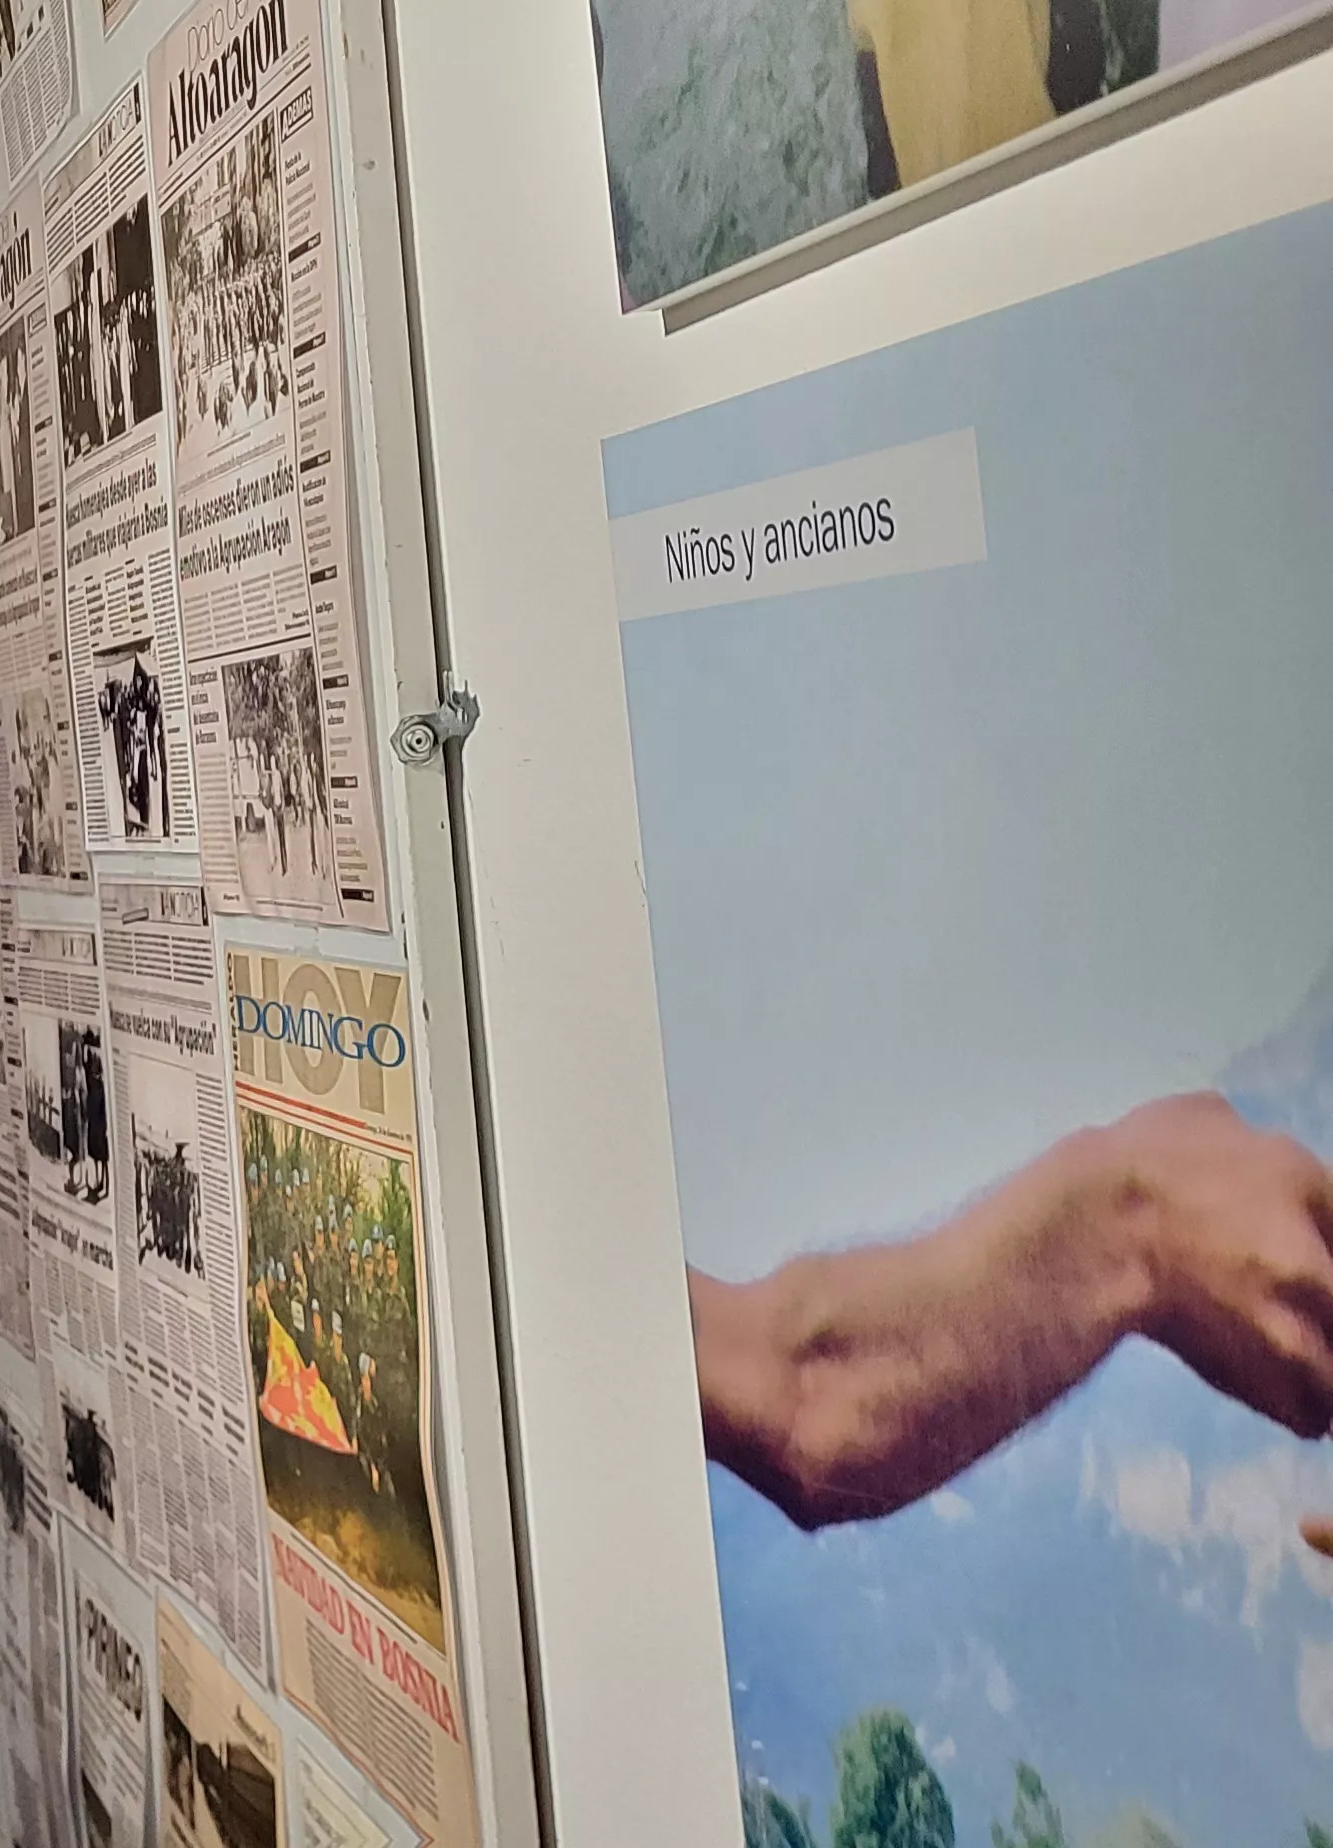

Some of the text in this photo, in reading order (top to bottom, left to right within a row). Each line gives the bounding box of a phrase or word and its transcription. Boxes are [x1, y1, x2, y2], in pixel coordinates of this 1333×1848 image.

[145, 495, 168, 534] Bosnia
[194, 498, 202, 531] de
[203, 490, 236, 527] oscenses
[236, 478, 261, 514] dieron
[260, 475, 272, 504] un
[272, 454, 294, 499] adiós
[180, 543, 207, 581] emotivo
[211, 537, 219, 571] la
[219, 519, 263, 574] Agrupación
[262, 506, 291, 556] Aragón
[665, 497, 896, 583] Niños y ancianos
[234, 954, 402, 1115] HOY
[235, 995, 406, 1068] DOMINGO
[346, 1600, 375, 1666] EN
